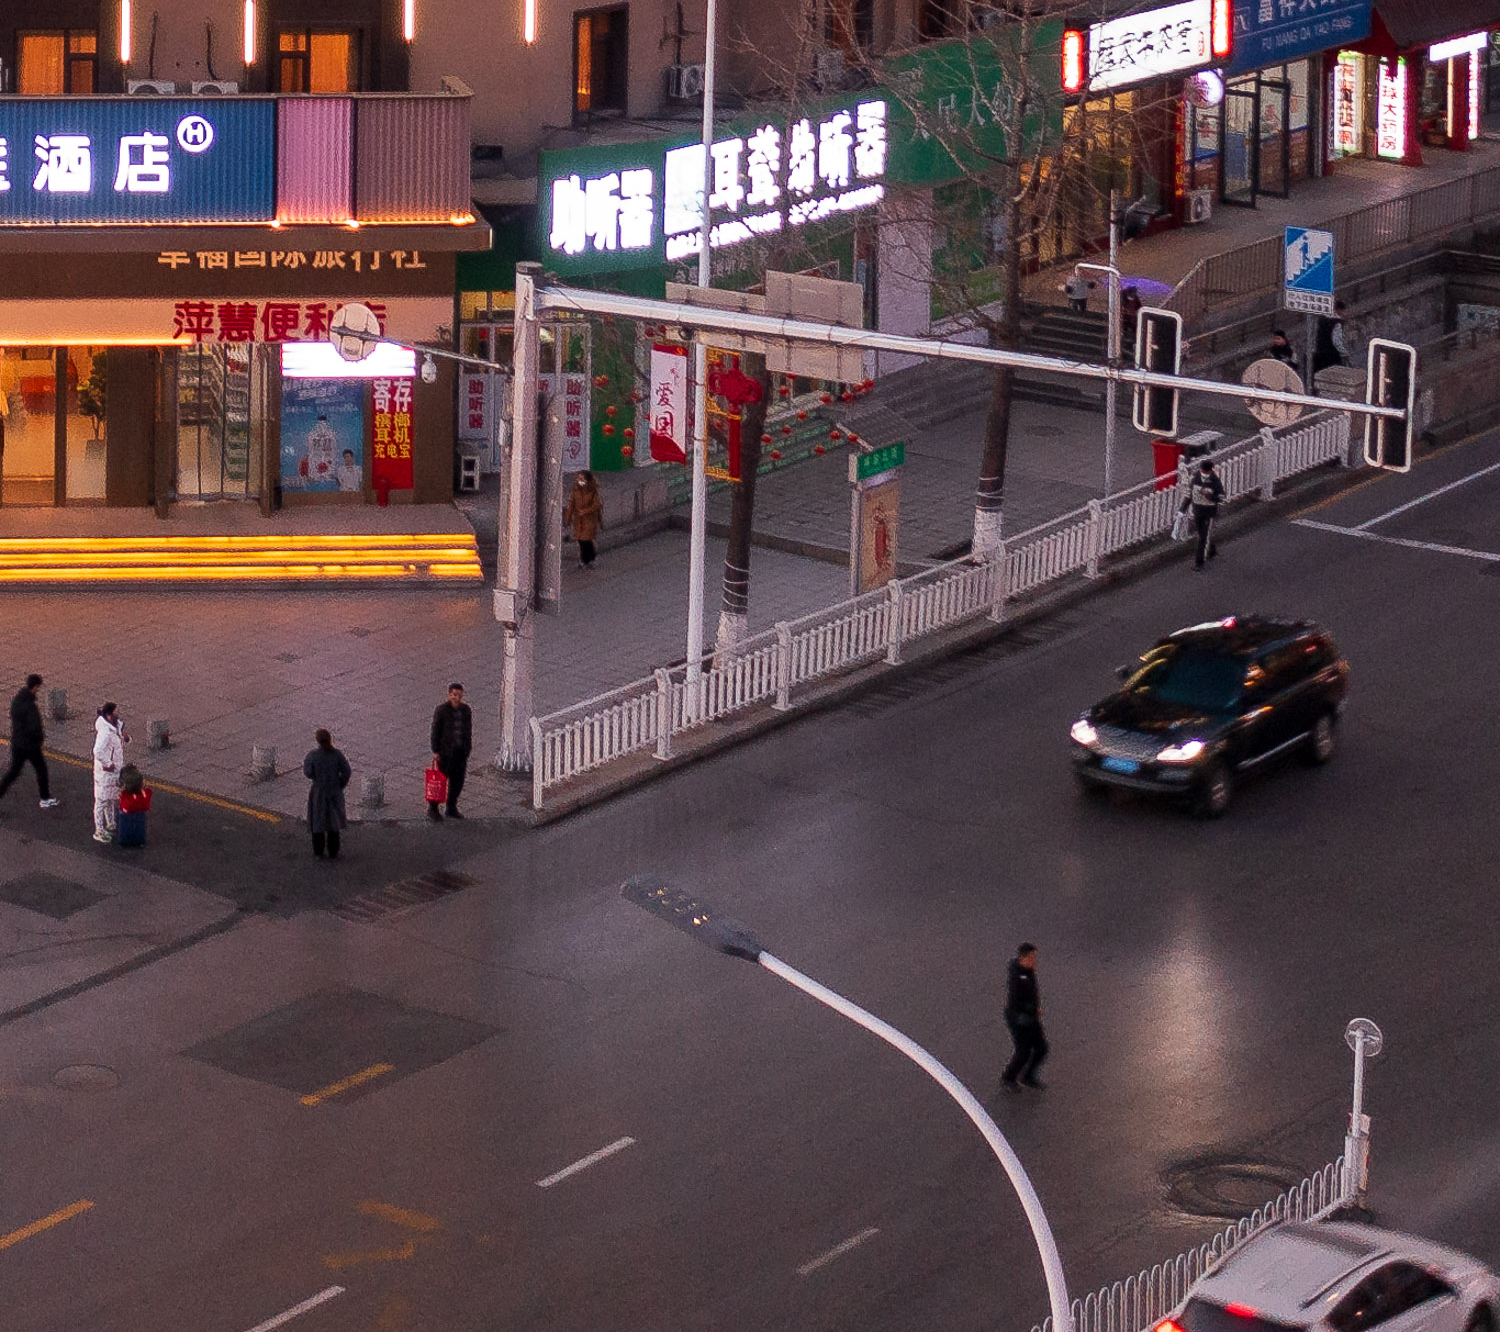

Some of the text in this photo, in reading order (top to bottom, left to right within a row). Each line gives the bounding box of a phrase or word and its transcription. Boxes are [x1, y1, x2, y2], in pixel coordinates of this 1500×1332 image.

[373, 378, 412, 414] 寄存
[654, 382, 675, 440] 爱国
[373, 428, 411, 444] 耳机
[373, 444, 411, 459] 充电宝
